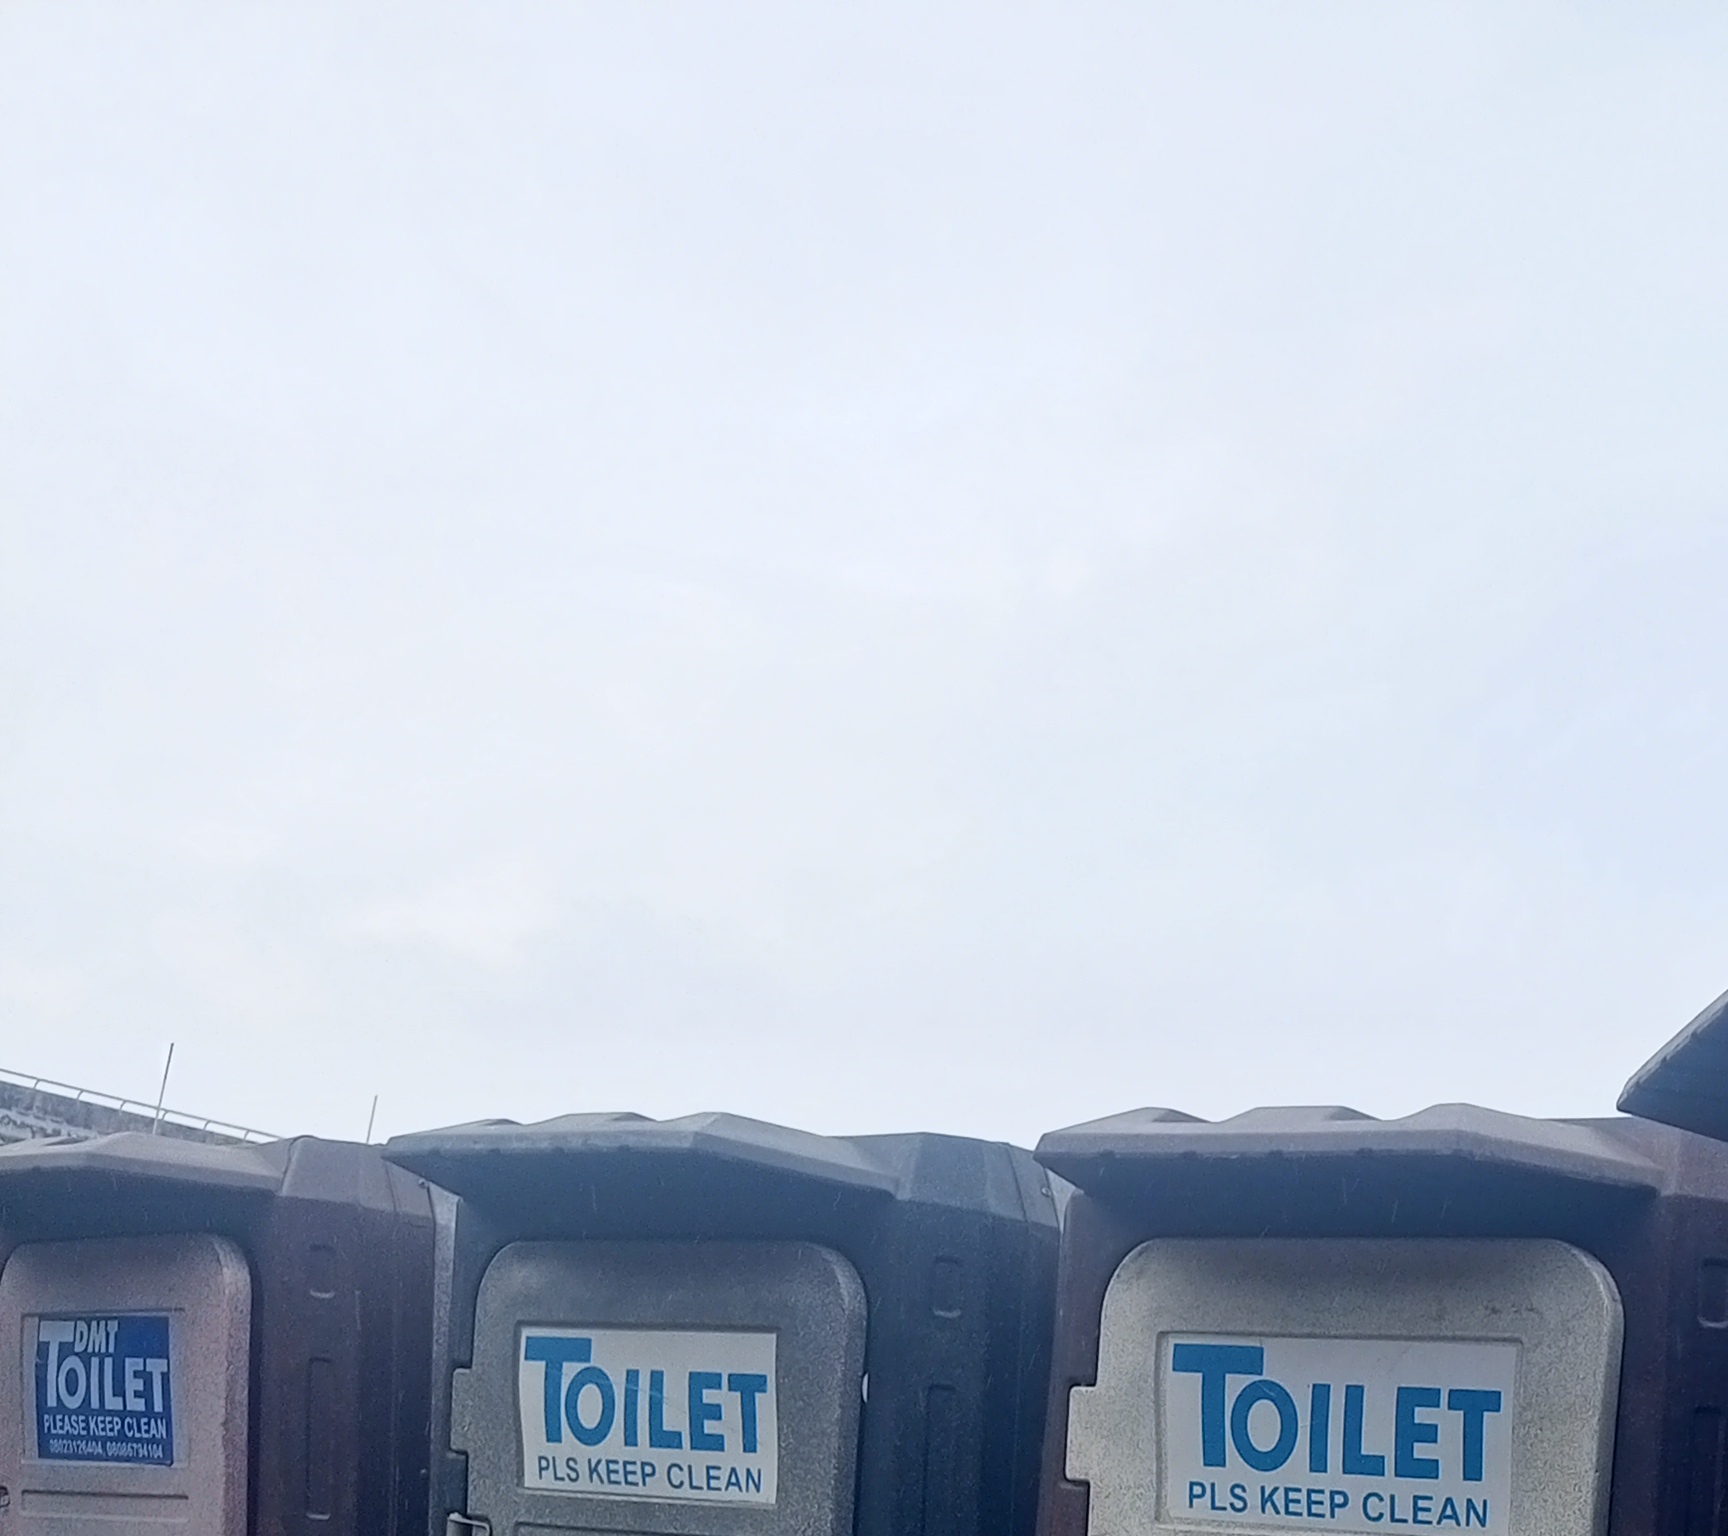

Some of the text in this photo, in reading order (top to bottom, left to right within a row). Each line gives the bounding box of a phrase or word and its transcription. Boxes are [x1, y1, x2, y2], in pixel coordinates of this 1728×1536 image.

[74, 1320, 119, 1353] DMT
[39, 1320, 168, 1413] TOILET
[524, 1336, 768, 1454] TOILET
[1172, 1343, 1502, 1482] TOILET
[43, 1414, 167, 1439] PLEASE KEEP CLEAN
[537, 1455, 762, 1494] PLS KEEP CLEAN
[1188, 1480, 1489, 1528] PLS KEEP CLEAN
